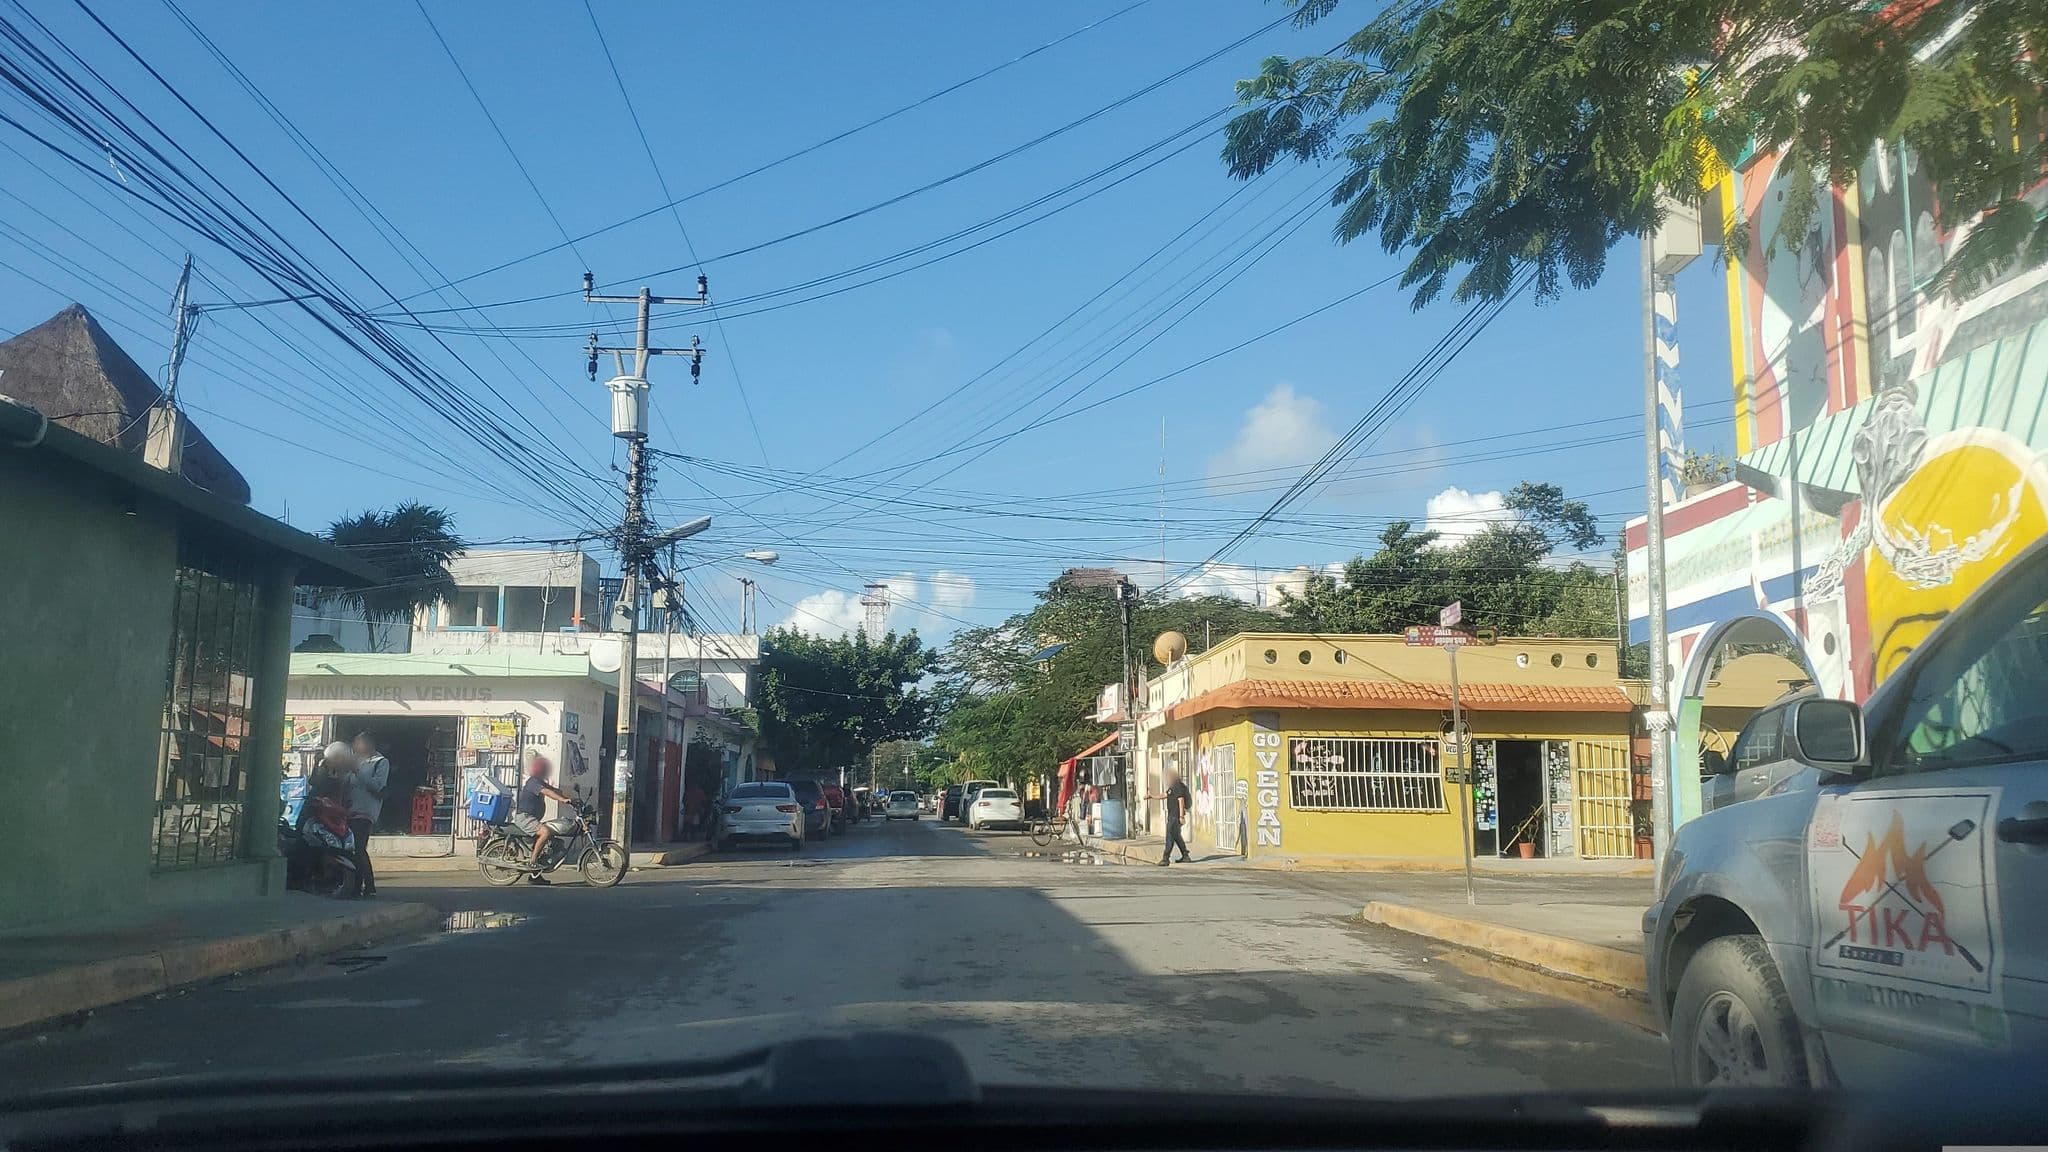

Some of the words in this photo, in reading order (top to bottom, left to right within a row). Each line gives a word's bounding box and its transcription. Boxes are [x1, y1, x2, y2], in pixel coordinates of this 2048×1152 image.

[302, 684, 344, 700] MINI
[351, 686, 402, 700] SUPER
[415, 686, 492, 701] VENUS
[1252, 732, 1281, 747] GO
[1256, 751, 1281, 846] VEGAN
[1839, 902, 1955, 956] TIKA
